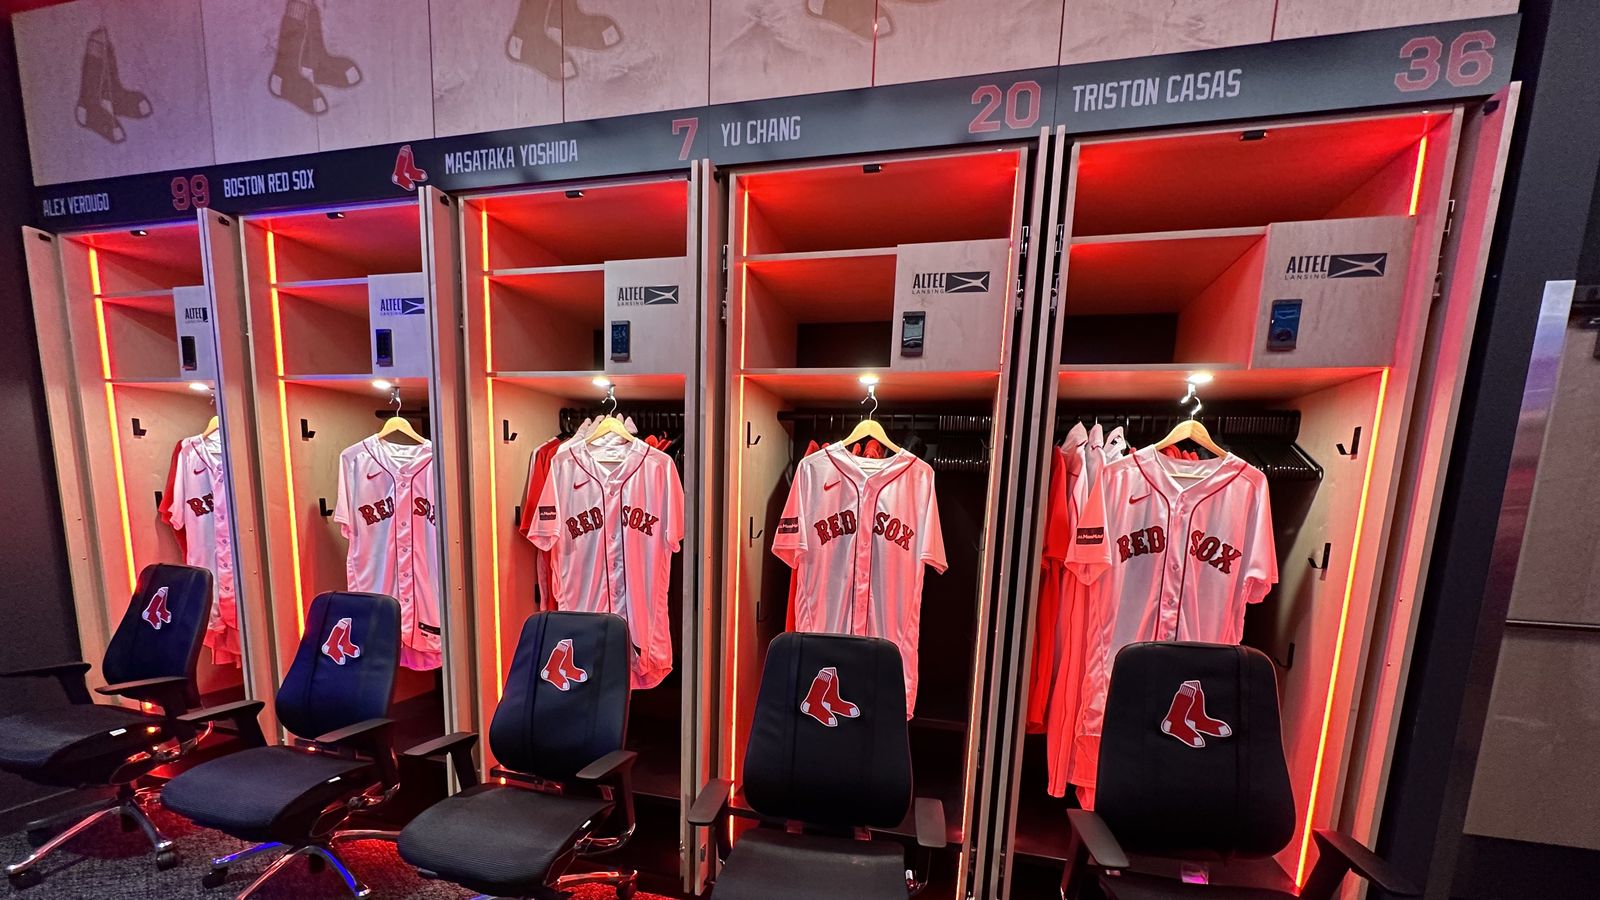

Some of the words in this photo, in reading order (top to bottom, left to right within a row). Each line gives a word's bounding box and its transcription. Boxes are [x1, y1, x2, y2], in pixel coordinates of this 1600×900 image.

[1394, 30, 1497, 92] 36
[968, 80, 1042, 134] 20
[1072, 77, 1160, 113] TRISTON
[1166, 68, 1243, 104] CASAS
[672, 117, 699, 161] 7
[721, 121, 742, 147] YU
[746, 115, 801, 145] CHANG
[445, 146, 515, 175] MASATAKA
[520, 139, 579, 167] YOSHIDA
[170, 174, 211, 211] 99
[223, 174, 266, 198] BOSTON
[267, 171, 290, 193] RED
[292, 168, 315, 190] SOX
[43, 198, 66, 217] ALEX
[67, 192, 110, 214] VERDUGO
[912, 272, 946, 289] ALTEC
[1284, 273, 1327, 281] LANSING
[1286, 254, 1329, 274] ALTEC
[380, 298, 402, 312] ALTEC
[618, 286, 644, 301] ALTEC
[358, 496, 395, 526] RED
[565, 506, 604, 540] RED
[622, 505, 660, 537] SOX
[814, 509, 857, 546] RED
[872, 511, 915, 551] SOX
[1116, 525, 1166, 563] RED
[1189, 529, 1243, 575] SOX
